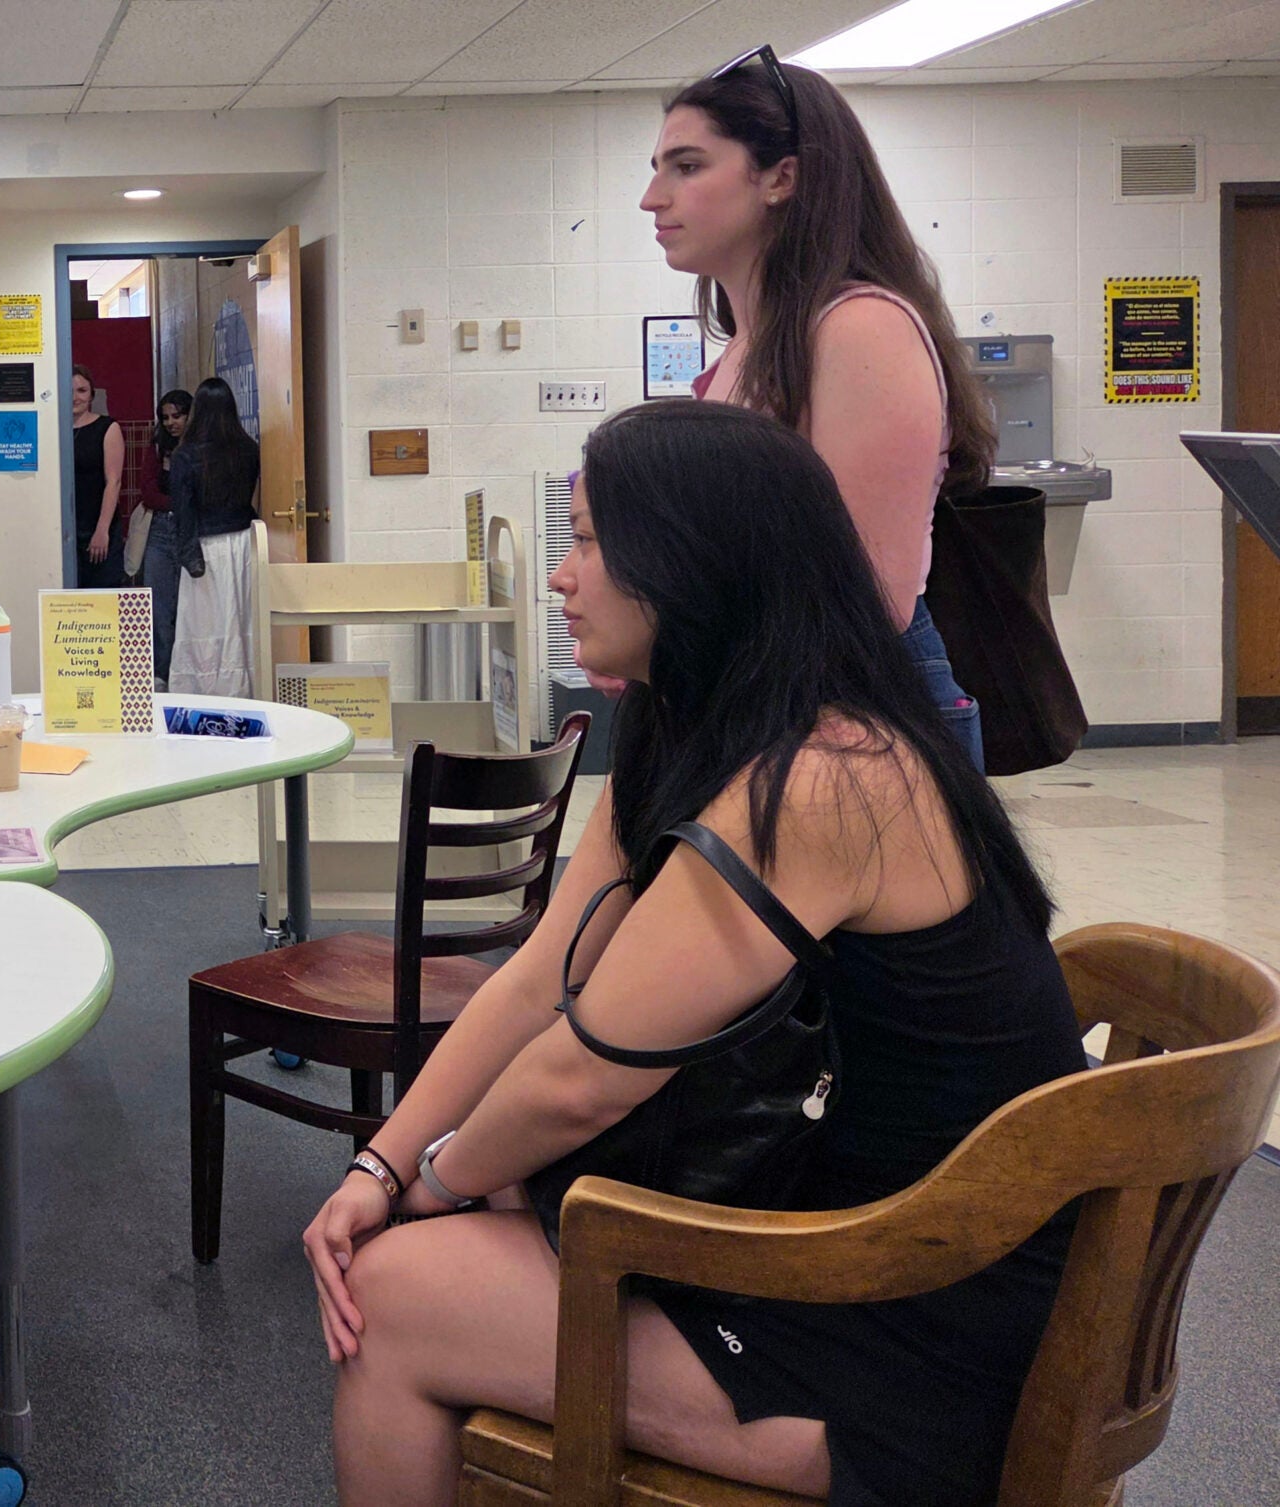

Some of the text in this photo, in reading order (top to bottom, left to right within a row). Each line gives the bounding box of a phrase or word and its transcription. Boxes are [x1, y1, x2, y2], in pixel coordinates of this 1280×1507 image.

[1113, 374, 1193, 385] DOES THIS SOUND LIKE
[1115, 386, 1134, 396] JUST
[57, 621, 112, 633] Indigenous
[54, 634, 115, 644] Luminaries:
[64, 647, 104, 655] Voices &
[71, 658, 99, 667] Living
[58, 669, 112, 678] Knowledge
